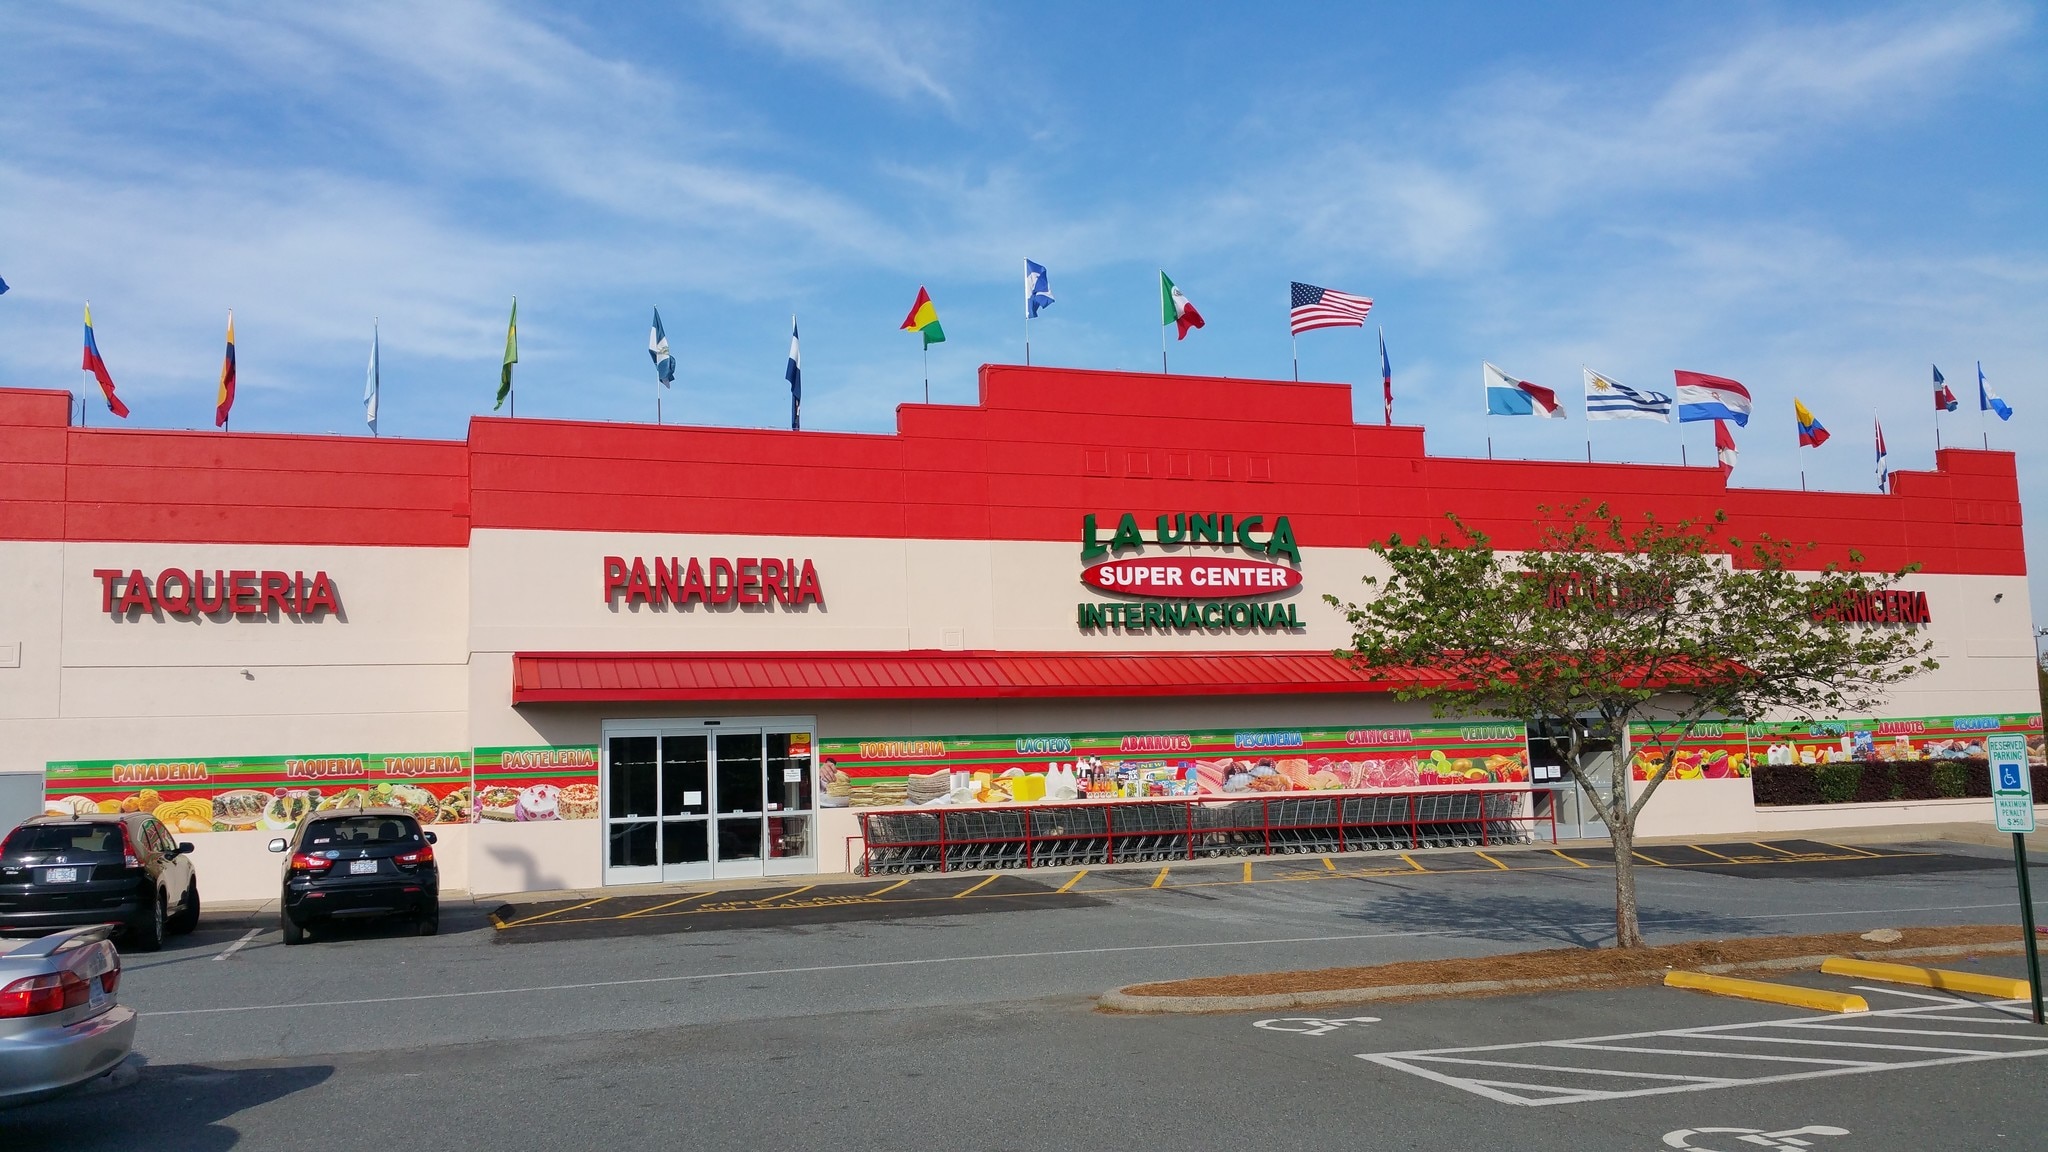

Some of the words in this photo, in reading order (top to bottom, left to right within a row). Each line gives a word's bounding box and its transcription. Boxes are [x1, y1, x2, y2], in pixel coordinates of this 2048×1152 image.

[1081, 513, 1143, 560] LA
[1157, 513, 1301, 563] UNICA
[604, 556, 823, 604] PANADERIA
[1100, 566, 1183, 586] SUPER
[1190, 567, 1288, 587] CENTER
[93, 568, 339, 614] TAQUERIA
[1078, 602, 1306, 628] INTERNACIONAL
[1461, 725, 1516, 741] VERDURAS
[1878, 721, 1925, 734] ABARROTES
[1120, 735, 1191, 752] ABARROTES
[1234, 731, 1303, 748] PESCADERIA
[1345, 728, 1413, 745] CARNICERIA
[859, 740, 945, 758] TORTILLERIA
[1016, 737, 1071, 754] LACTEOS
[1990, 741, 2023, 751] RESERVED
[501, 749, 593, 769] PASTELERIA
[1994, 751, 2023, 761] PARKING
[112, 762, 208, 782] PANADERIA
[285, 759, 364, 779] TAQUERIA
[383, 756, 462, 777] TAQUERIA
[2000, 800, 2027, 808] MAXIMUM
[2002, 809, 2026, 817] PENALTY
